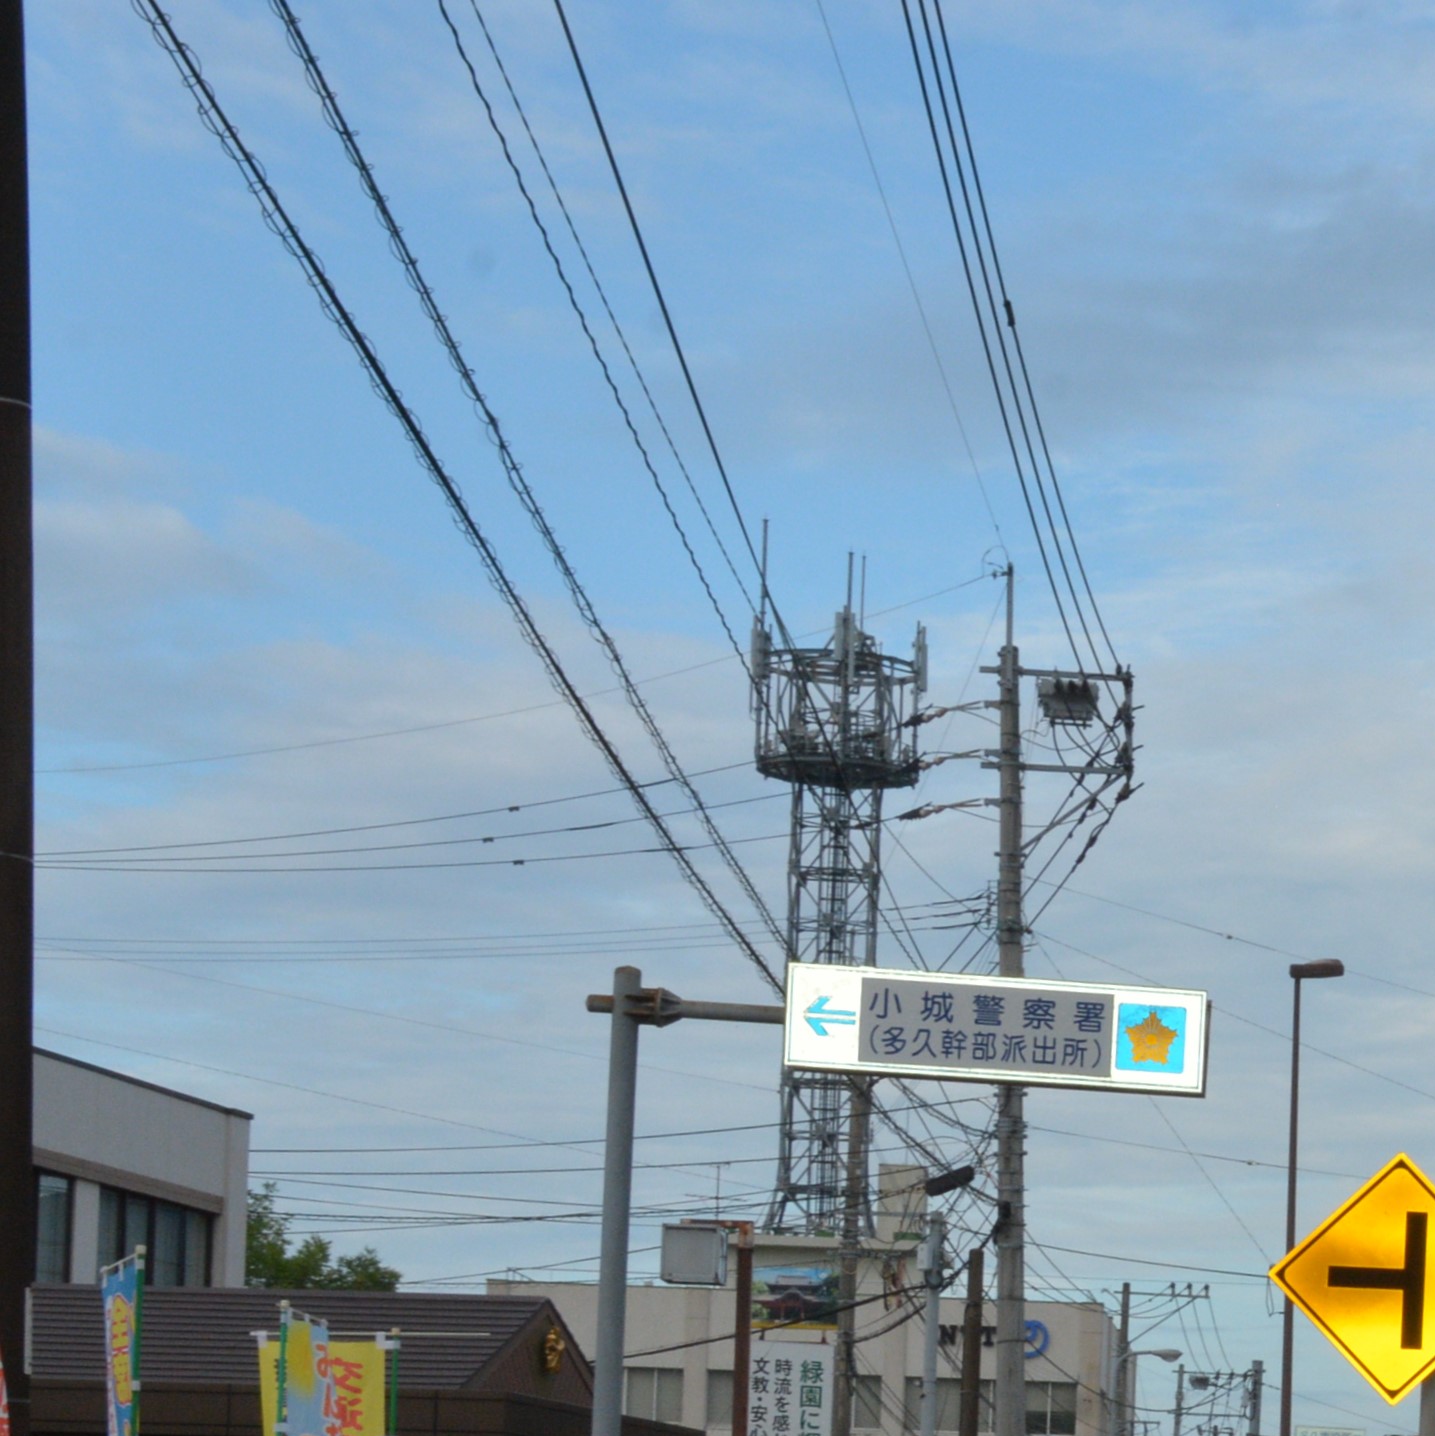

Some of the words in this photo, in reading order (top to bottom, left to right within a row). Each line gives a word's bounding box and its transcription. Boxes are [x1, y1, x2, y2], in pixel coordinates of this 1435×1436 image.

[868, 986, 1106, 1033] 小城警察署
[938, 1324, 997, 1347] NT
